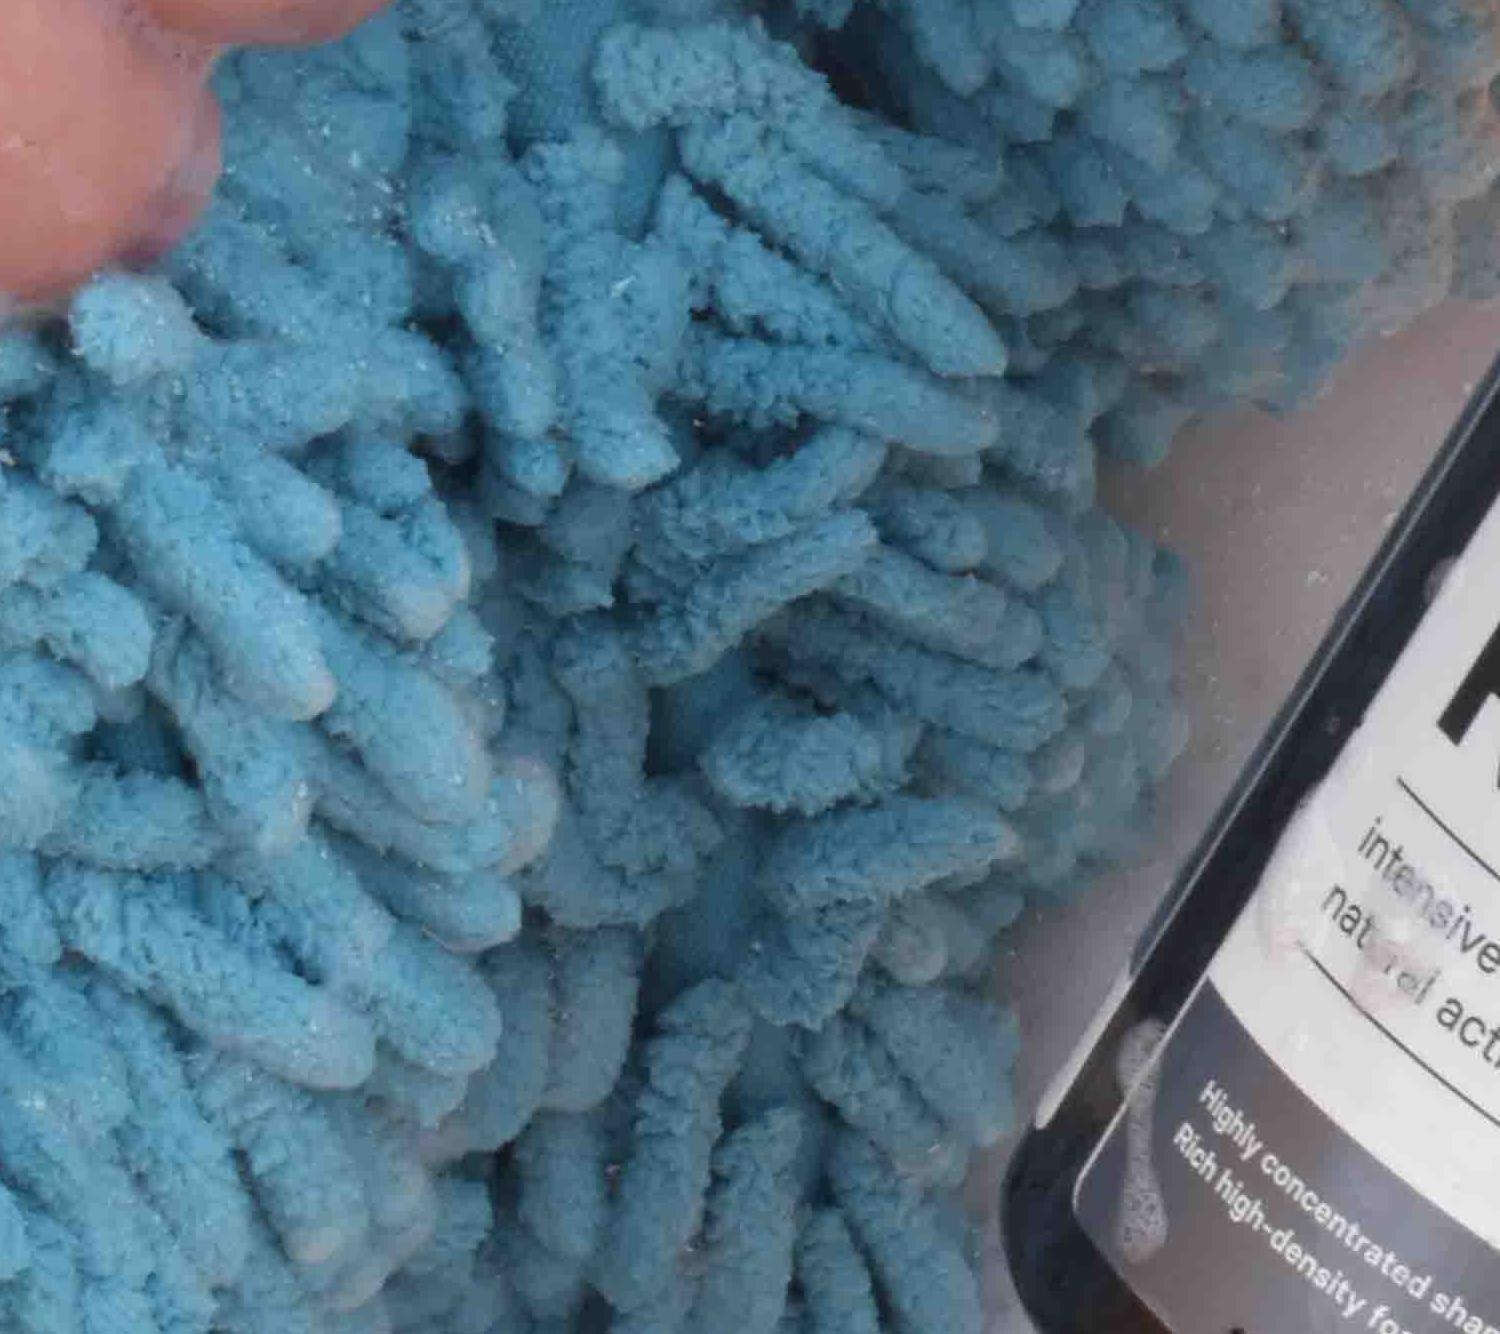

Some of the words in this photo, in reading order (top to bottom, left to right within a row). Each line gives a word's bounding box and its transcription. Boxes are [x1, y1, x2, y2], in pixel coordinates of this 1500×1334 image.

[1321, 883, 1442, 1005] natral
[1172, 1121, 1219, 1184] Rich
[1213, 1170, 1369, 1319] high-density
[1199, 1079, 1264, 1162] Highly
[1260, 1152, 1434, 1300] concentrated
